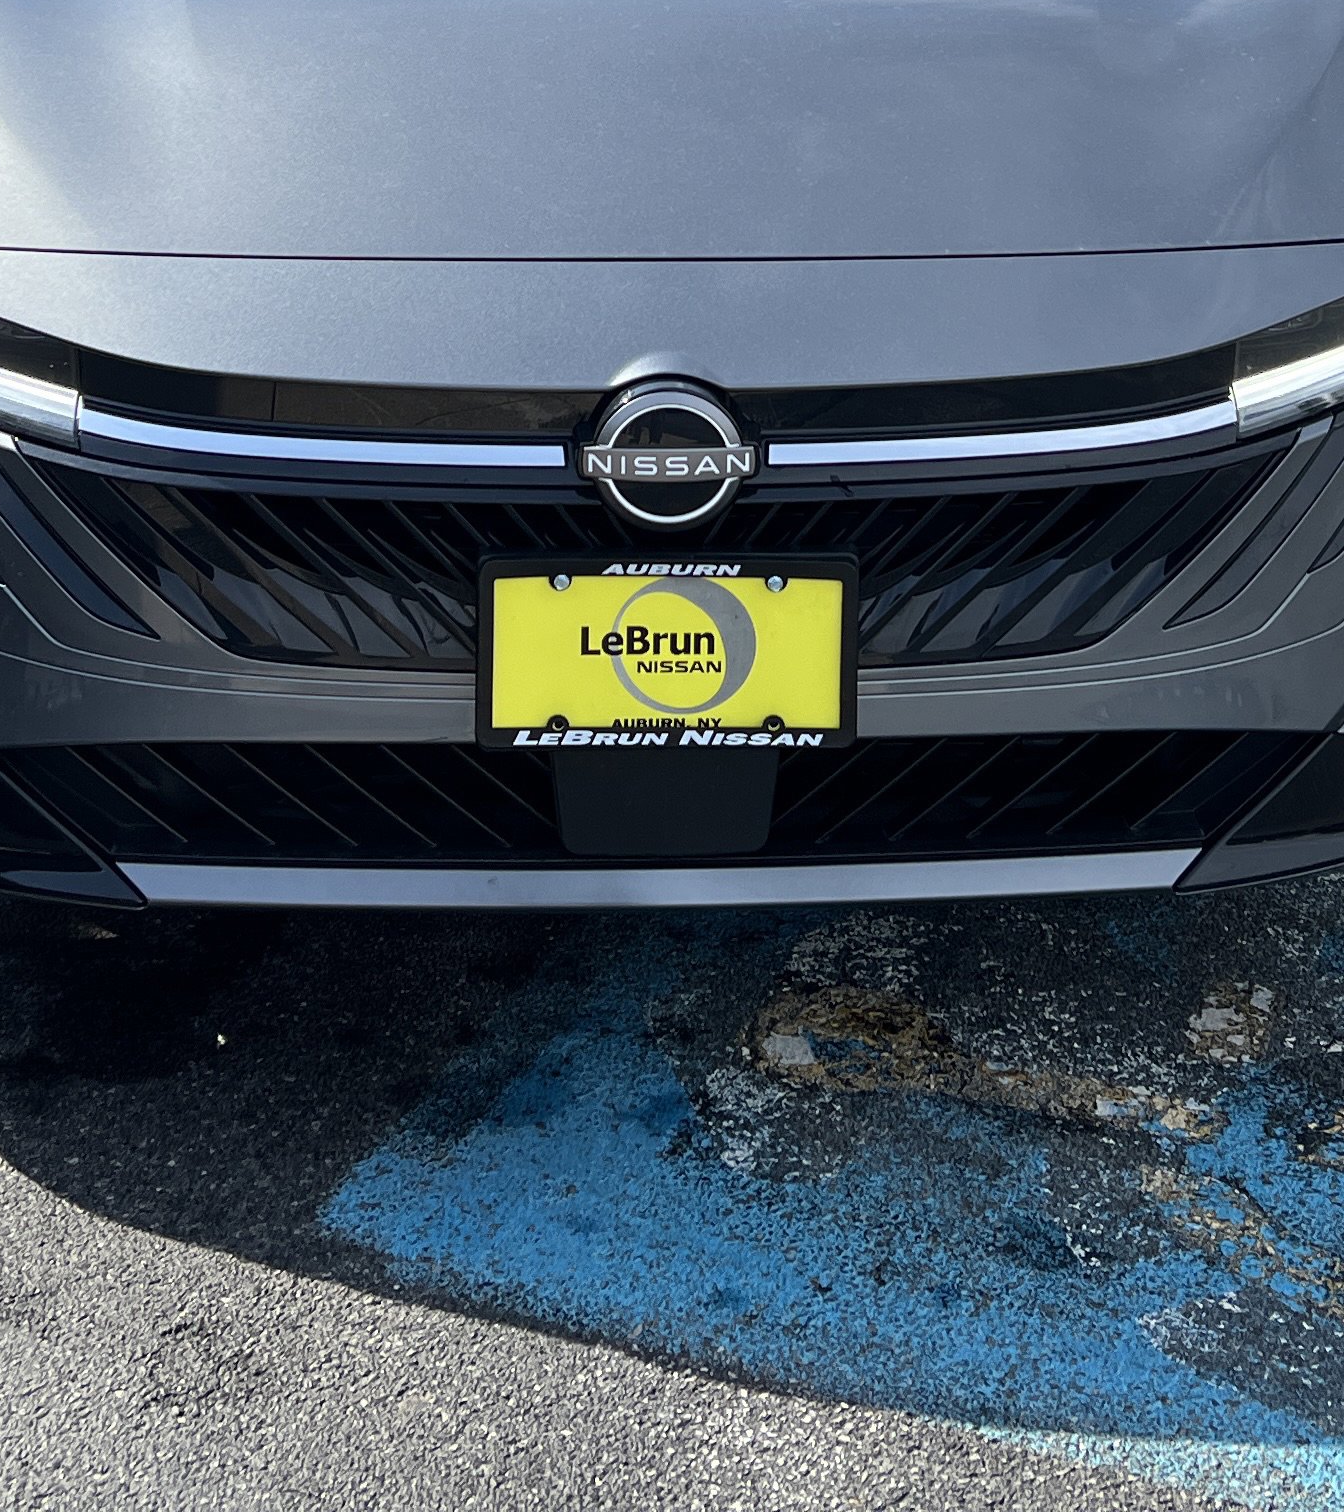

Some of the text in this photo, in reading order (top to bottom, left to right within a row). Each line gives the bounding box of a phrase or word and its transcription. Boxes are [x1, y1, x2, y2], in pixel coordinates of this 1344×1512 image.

[587, 451, 752, 477] NISSAN
[601, 563, 742, 577] AUBURN
[580, 626, 715, 656] LeBrun
[636, 660, 723, 674] NISSAN
[697, 718, 722, 728] NY
